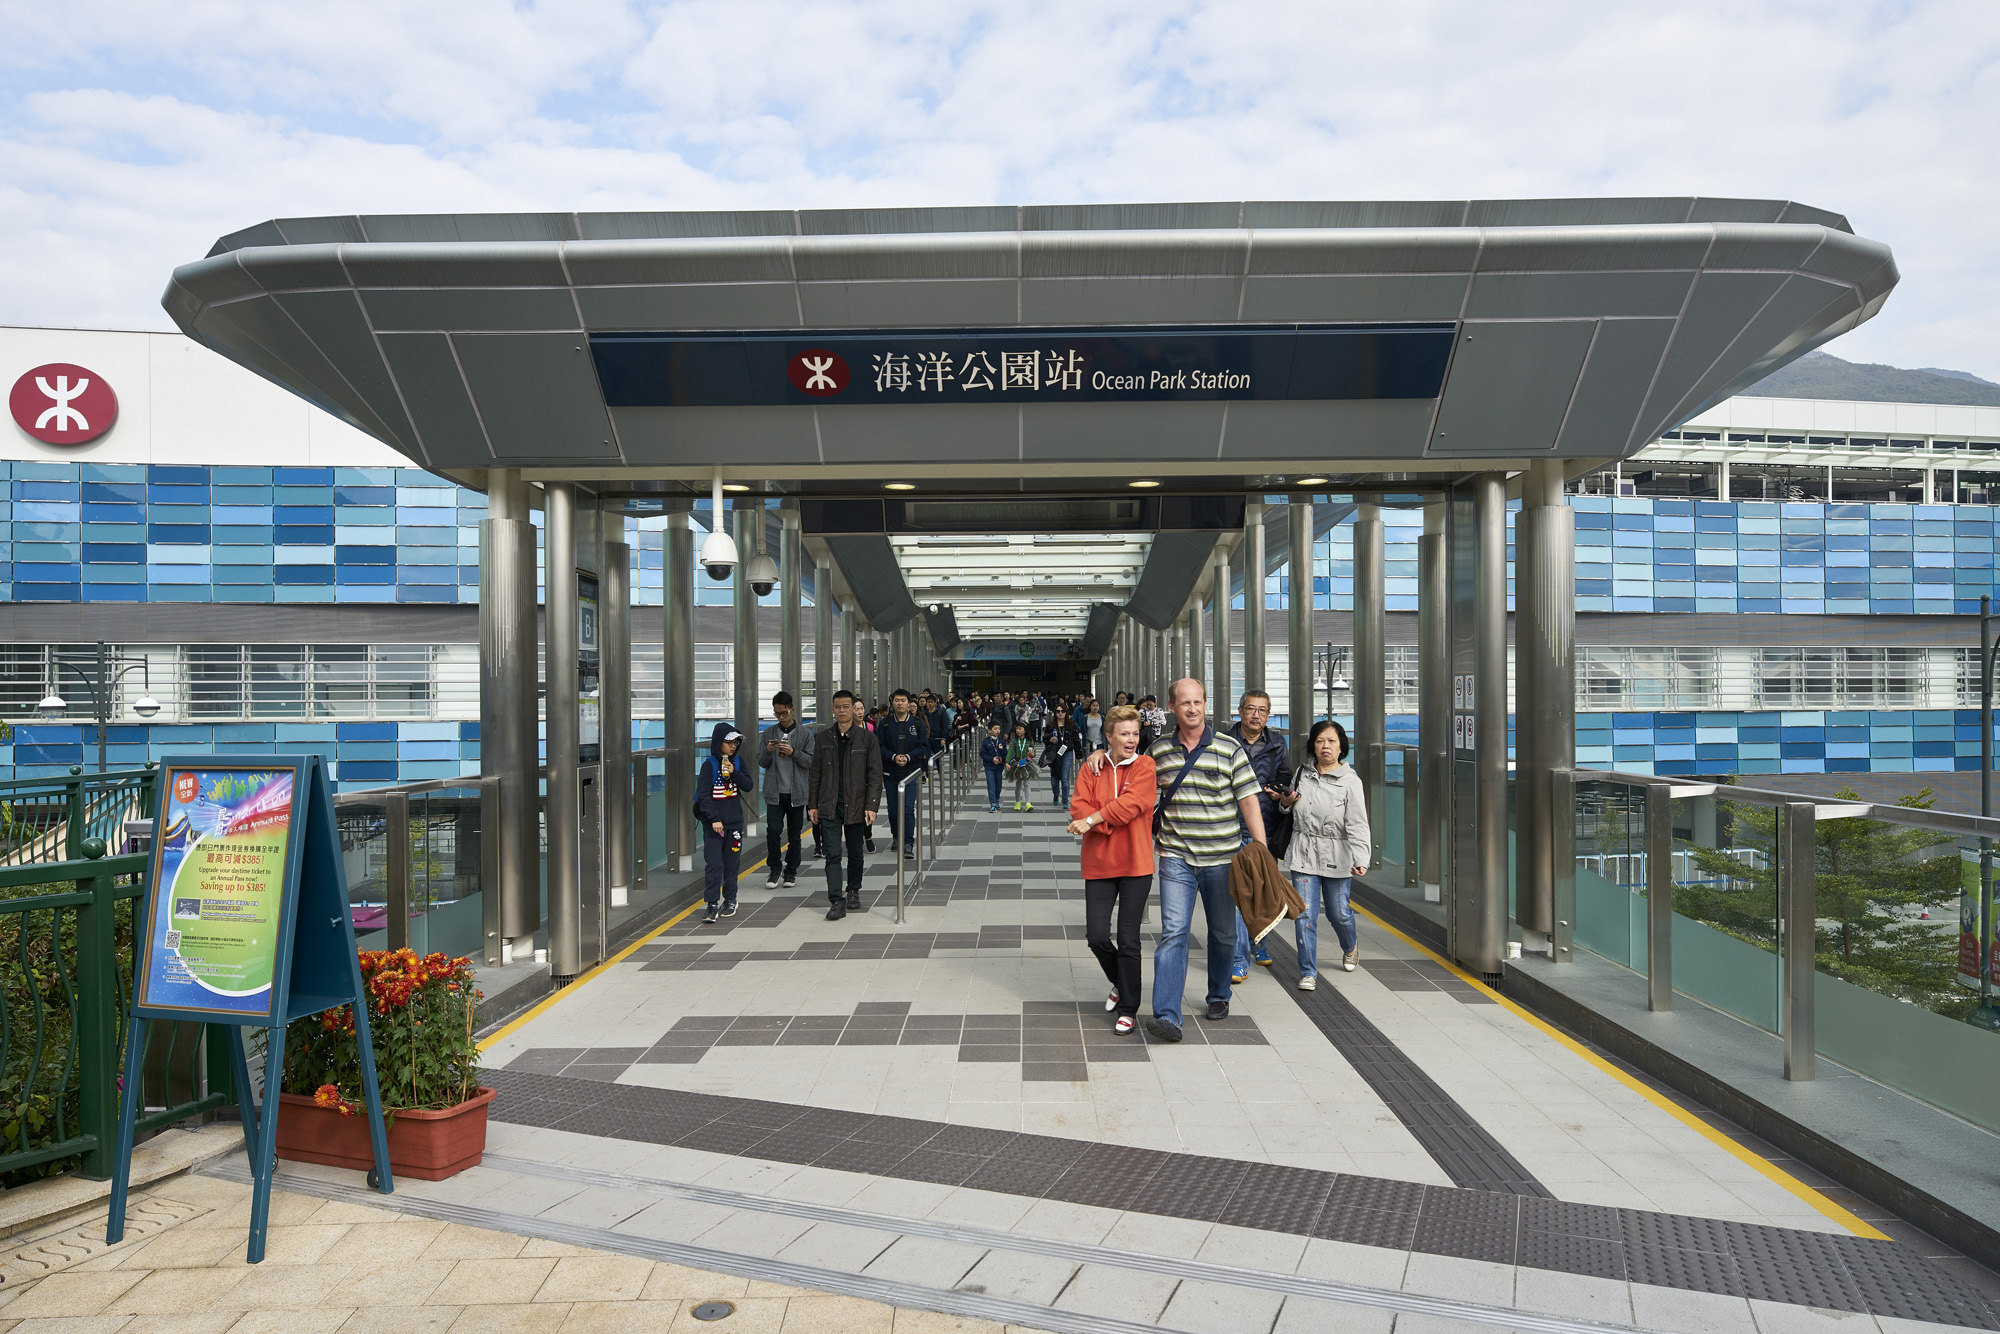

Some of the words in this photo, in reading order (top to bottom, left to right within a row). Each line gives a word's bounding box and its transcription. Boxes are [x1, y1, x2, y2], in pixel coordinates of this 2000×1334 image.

[871, 349, 1085, 393] 海洋公園站
[1092, 370, 1145, 390] Ocean
[1150, 369, 1187, 390] Park
[1190, 369, 1251, 389] Station
[585, 614, 592, 638] B
[179, 778, 194, 791] NEW
[180, 789, 193, 799] 全新
[250, 816, 274, 829] Annual
[274, 813, 289, 823] Pass
[231, 867, 250, 875] daytime
[200, 881, 223, 893] Saving
[225, 884, 235, 893] up
[236, 883, 245, 892] to
[246, 882, 267, 892] $385!
[1975, 1010, 1987, 1019] 入口
